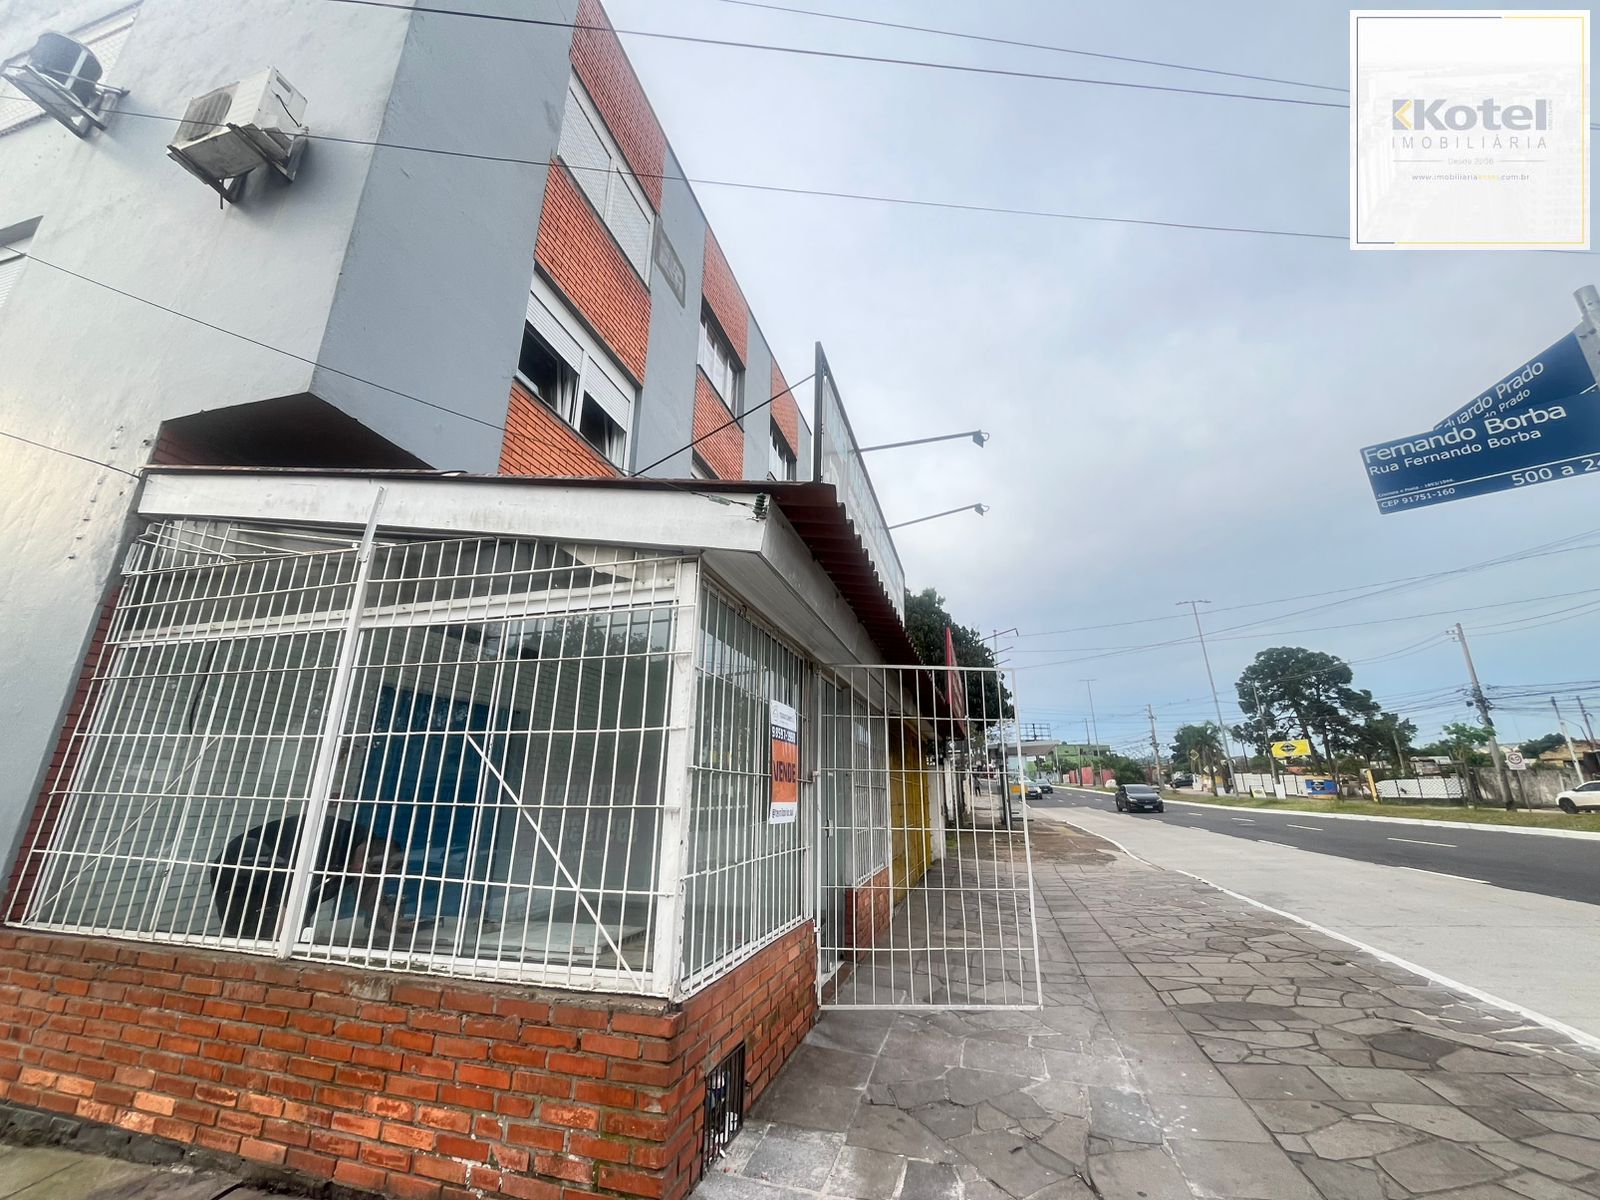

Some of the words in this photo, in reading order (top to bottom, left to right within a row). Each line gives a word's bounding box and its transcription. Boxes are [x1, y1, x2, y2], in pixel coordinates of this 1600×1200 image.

[1496, 361, 1544, 400] Prado
[1498, 388, 1531, 413] Prado
[1363, 427, 1477, 463] Fernando
[1483, 405, 1567, 435] Borba
[1369, 463, 1400, 476] Rua
[1404, 443, 1482, 468] Fernando
[1487, 430, 1542, 449] Borba
[1511, 467, 1553, 486] 500
[1560, 465, 1575, 476] a
[1381, 499, 1400, 508] CEP
[1402, 487, 1456, 504] 91751-160
[773, 760, 796, 783] VENDE
